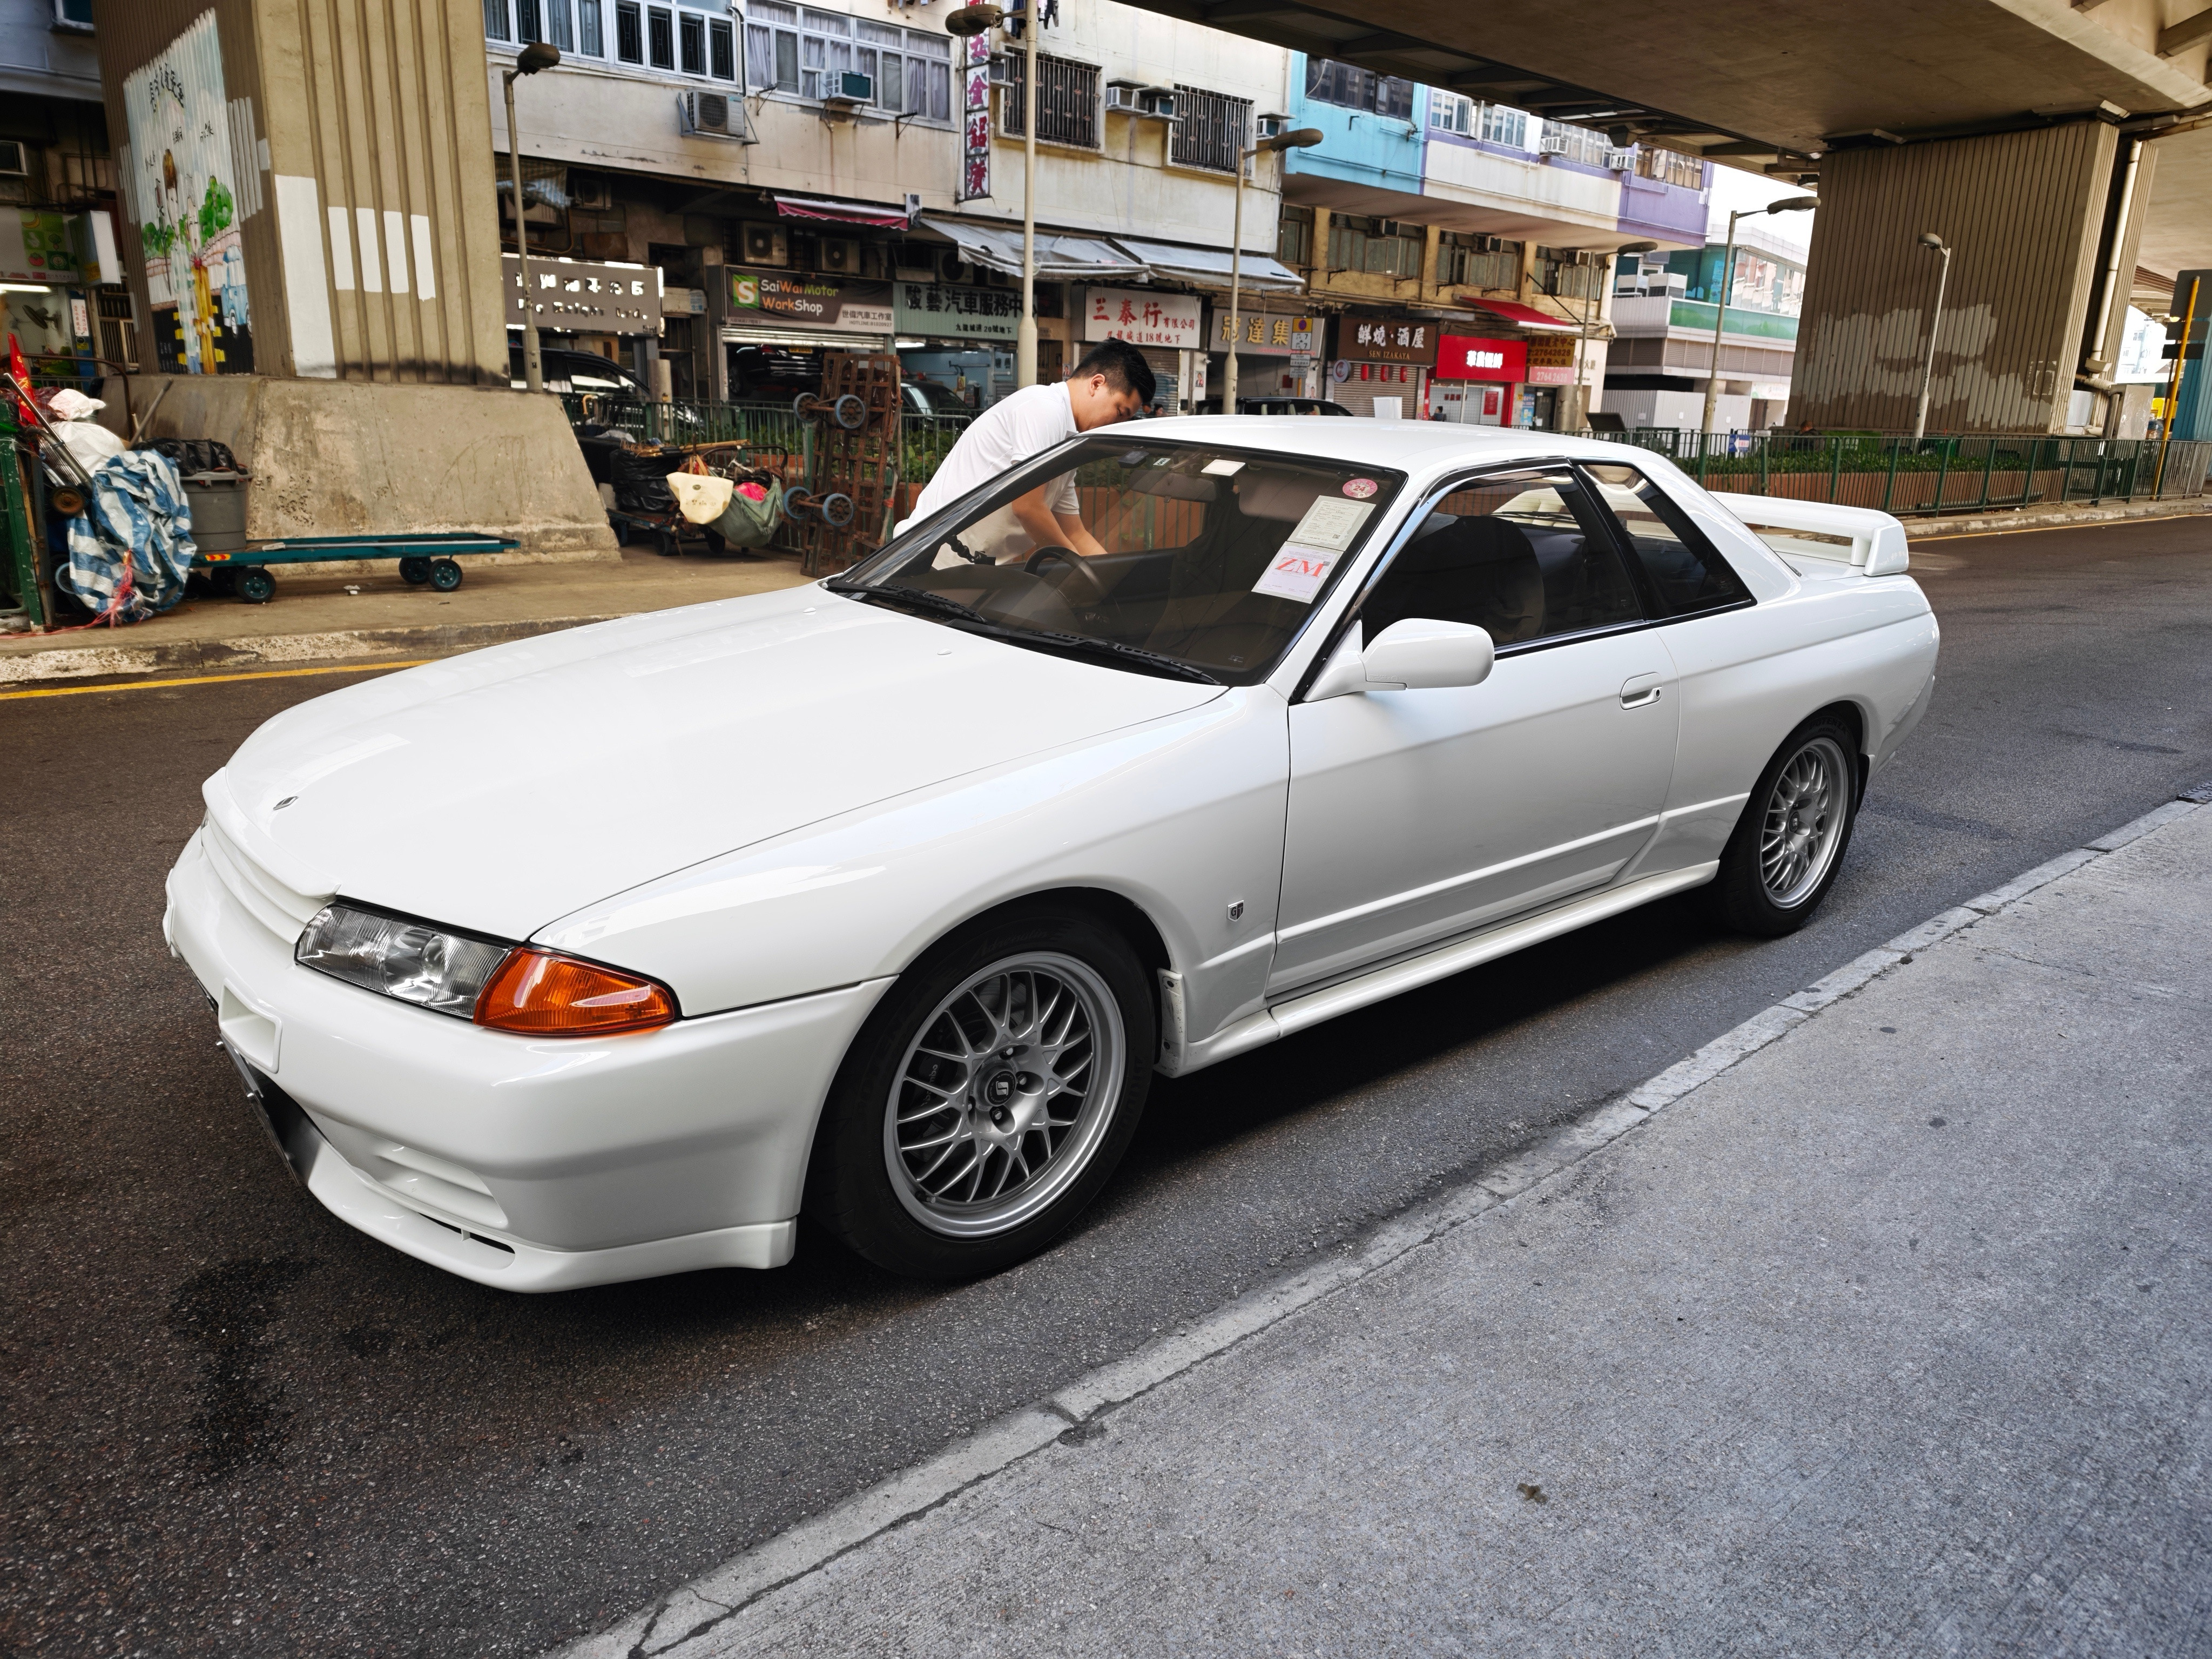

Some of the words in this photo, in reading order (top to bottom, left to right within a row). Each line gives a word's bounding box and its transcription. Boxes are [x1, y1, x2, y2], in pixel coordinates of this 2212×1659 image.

[760, 279, 802, 295] SaiWai
[804, 284, 838, 297] Motor
[761, 296, 823, 316] WorkShop
[1092, 298, 1163, 328] 三泰行
[1163, 316, 1195, 331] 有限公司
[1368, 350, 1380, 358] SEN
[1383, 351, 1411, 360] IZAKAYA
[1274, 557, 1325, 577] ZM
[1231, 906, 1244, 917] GT
